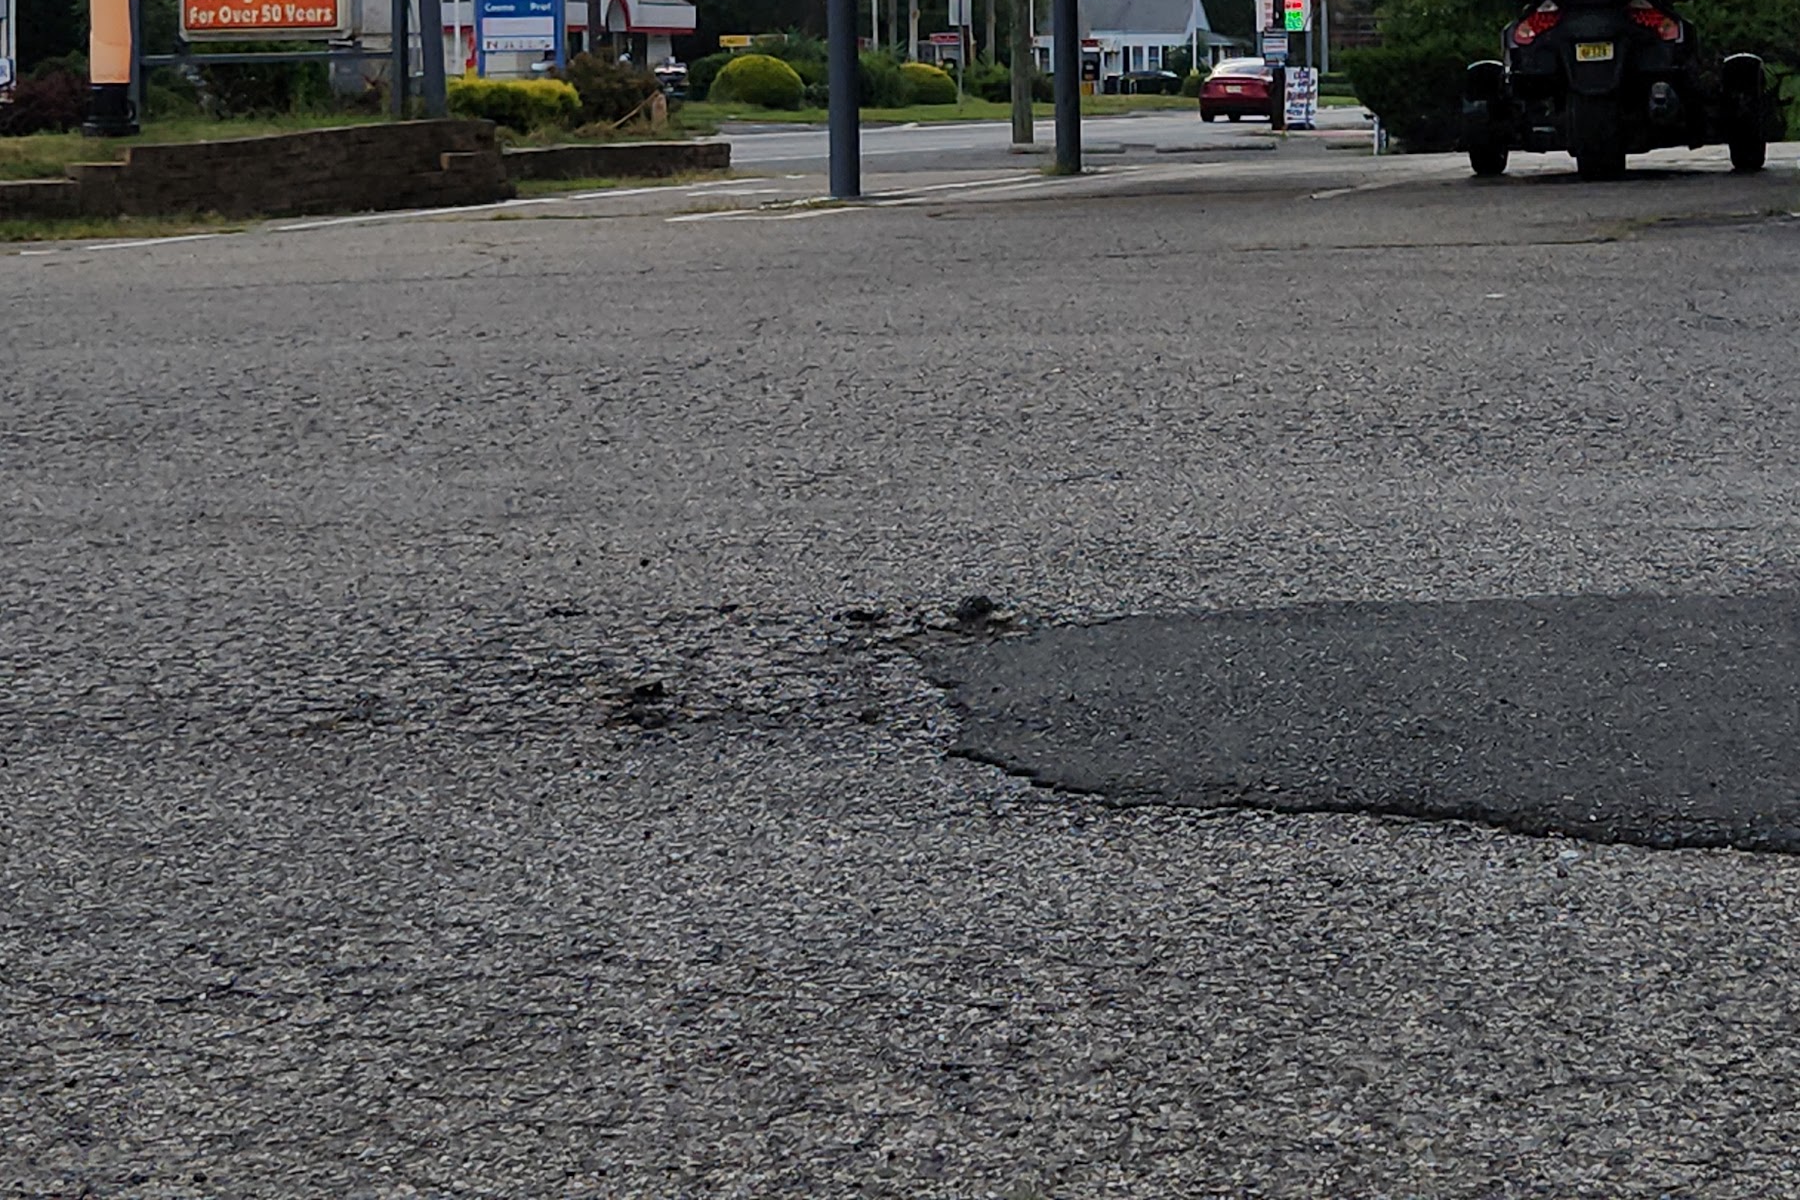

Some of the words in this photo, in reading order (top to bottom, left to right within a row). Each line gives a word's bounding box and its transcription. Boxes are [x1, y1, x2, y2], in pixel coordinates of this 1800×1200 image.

[189, 6, 216, 25] For
[220, 5, 259, 24] Over
[261, 4, 282, 22] 50
[285, 3, 334, 23] Years
